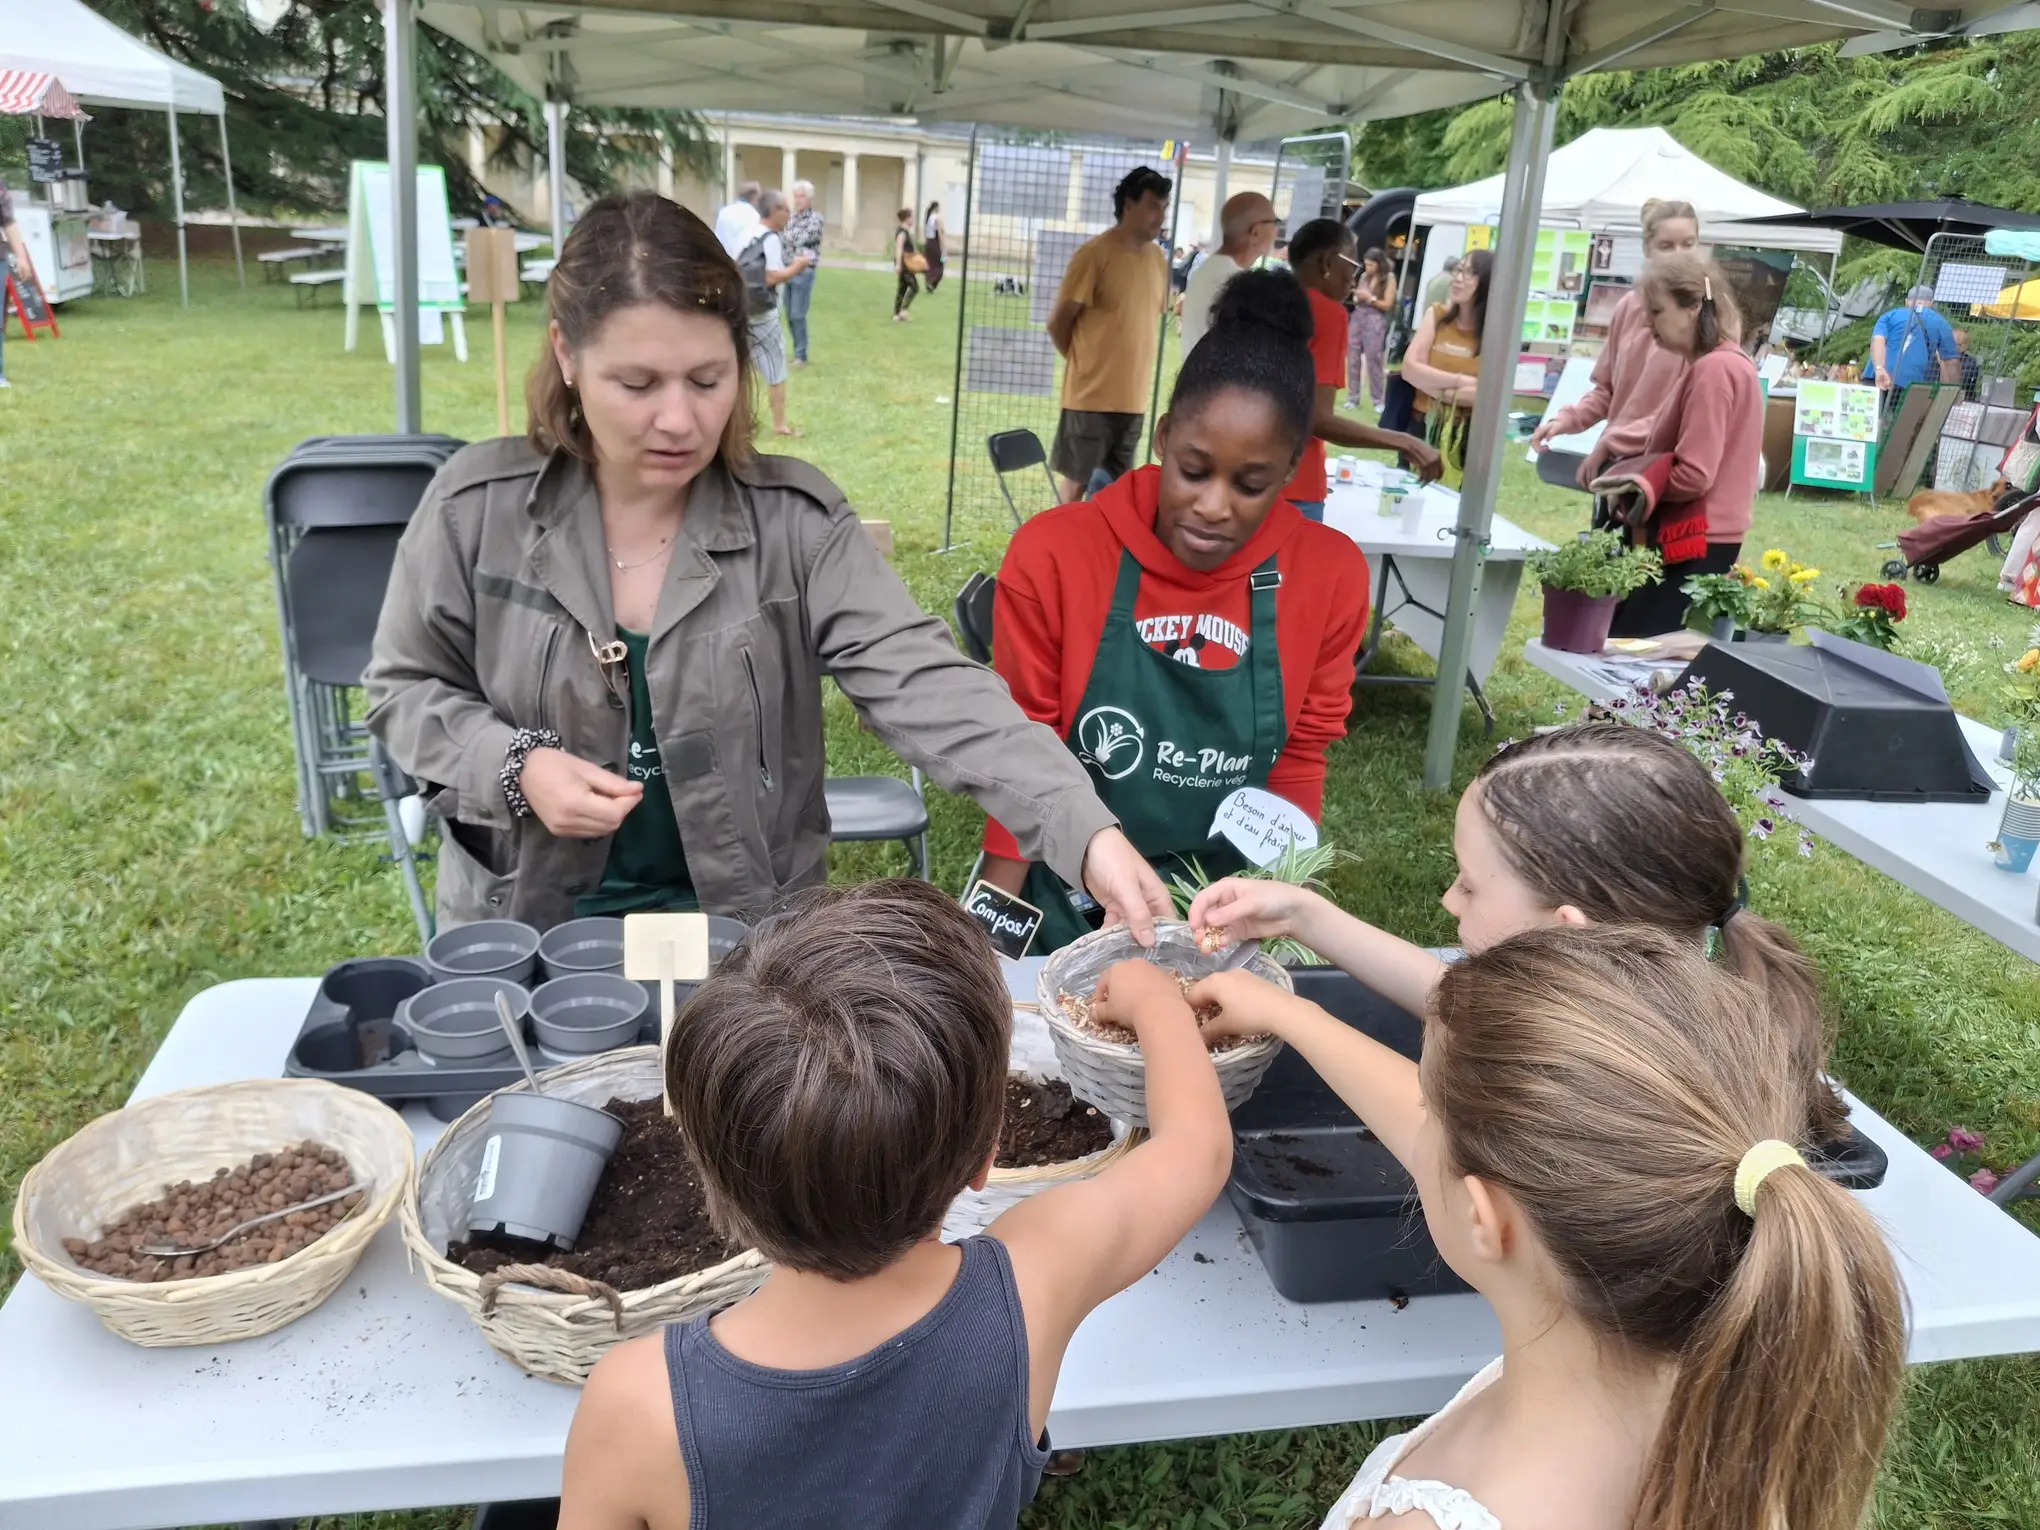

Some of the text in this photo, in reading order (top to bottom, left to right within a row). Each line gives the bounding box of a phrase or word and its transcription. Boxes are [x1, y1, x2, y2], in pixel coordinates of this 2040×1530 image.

[1156, 741, 1253, 774] Re-Plan
[1152, 767, 1222, 788] Recyclerie
[1233, 791, 1265, 820] Besoin
[1223, 807, 1234, 820] et
[1236, 816, 1260, 836] d'eau
[968, 892, 1035, 937] Compost
